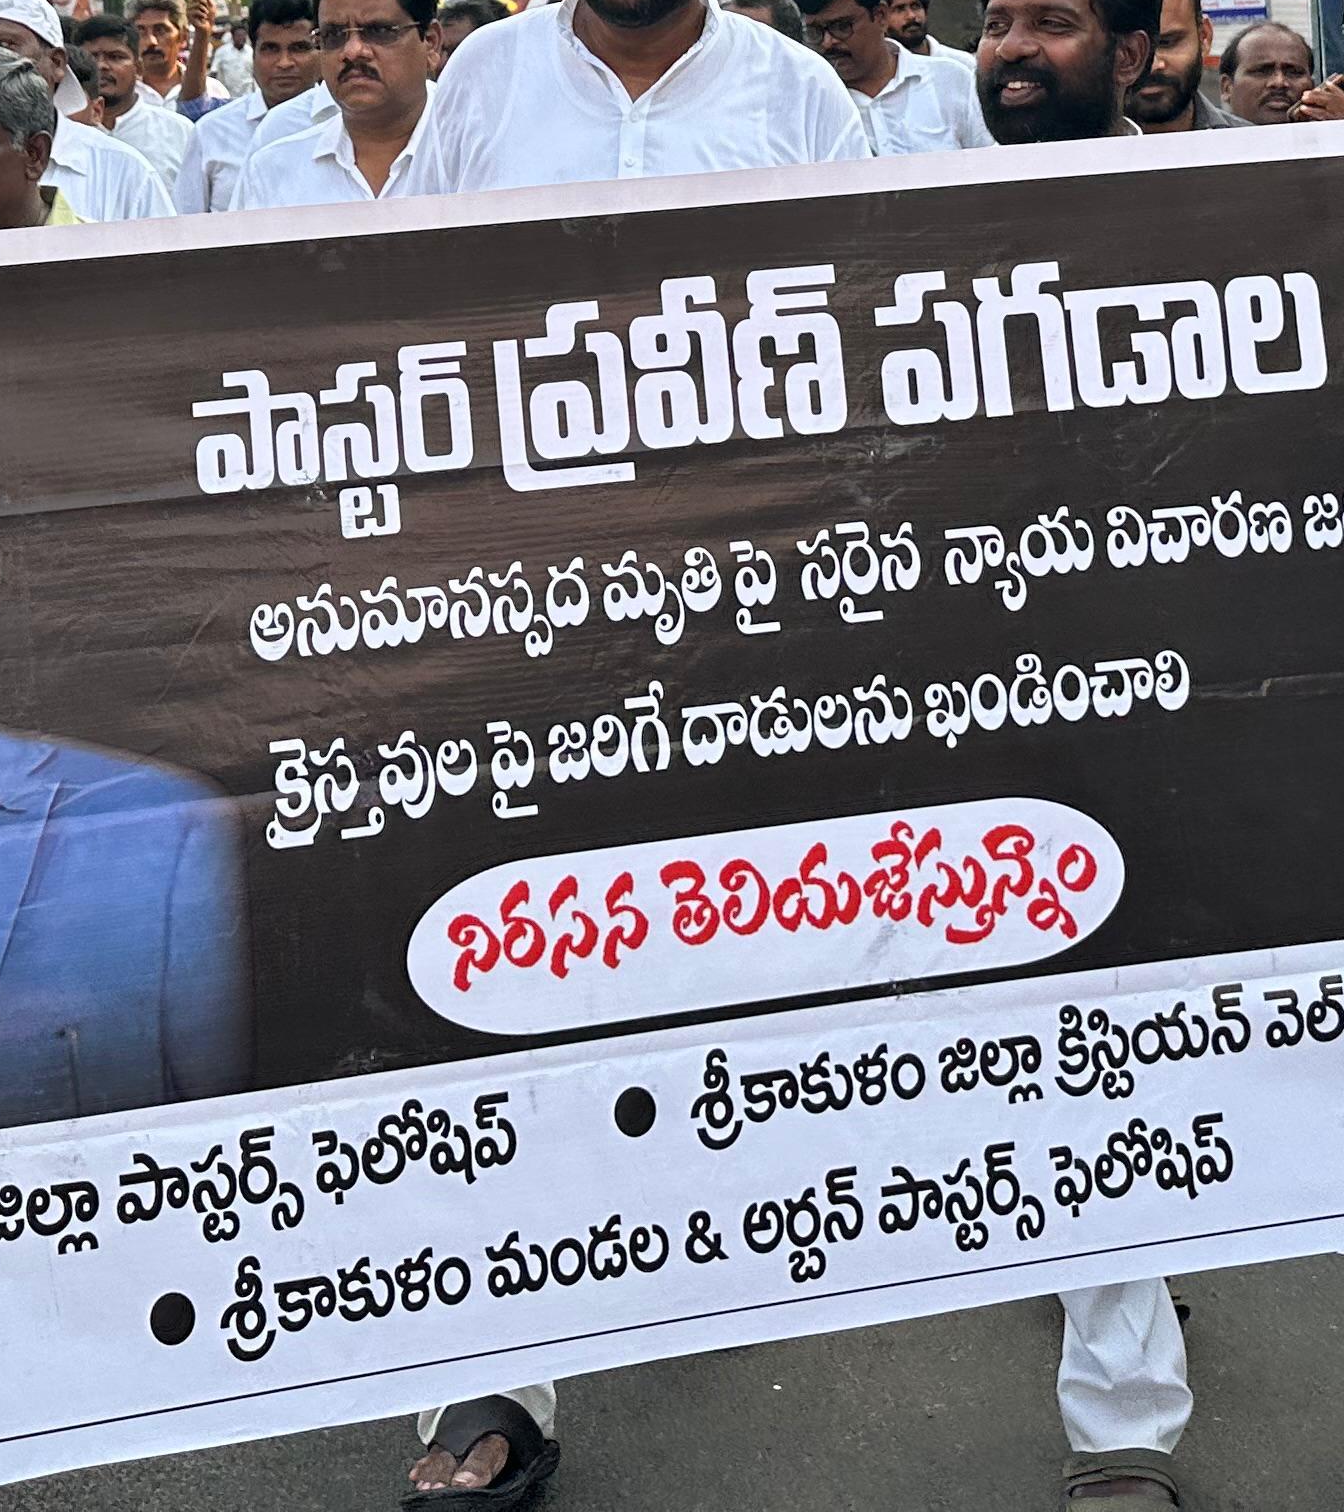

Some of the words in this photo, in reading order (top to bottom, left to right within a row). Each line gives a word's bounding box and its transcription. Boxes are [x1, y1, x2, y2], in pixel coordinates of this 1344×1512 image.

[190, 340, 475, 540] పాస్టర్
[490, 263, 849, 492] ప్రవీణ్
[872, 261, 1329, 427] పగడాల
[796, 520, 922, 624] సరైన
[943, 504, 1096, 613] న్యాయ
[1105, 489, 1295, 568] విచారణ
[547, 679, 673, 784] జరిగే
[680, 673, 914, 766] దాడులను
[923, 649, 1191, 749] ఖండించాలి
[446, 871, 651, 992] నిరసన
[690, 1041, 927, 1151] శ్రీకాకుళం
[938, 1033, 1044, 1105] జిల్లా
[1054, 982, 1253, 1101] క్రిస్టియన్
[116, 1124, 306, 1244] పాస్టర్స్
[311, 1090, 517, 1206] ఫెలోషిప్
[219, 1246, 472, 1362] శ్రీకాకుళం
[485, 1213, 670, 1298] మండల
[684, 1209, 730, 1265] &
[742, 1165, 865, 1284] అర్బన్
[877, 1140, 1047, 1252] పాస్టర్స్
[1048, 1111, 1235, 1218] ఫెలోషిప్
